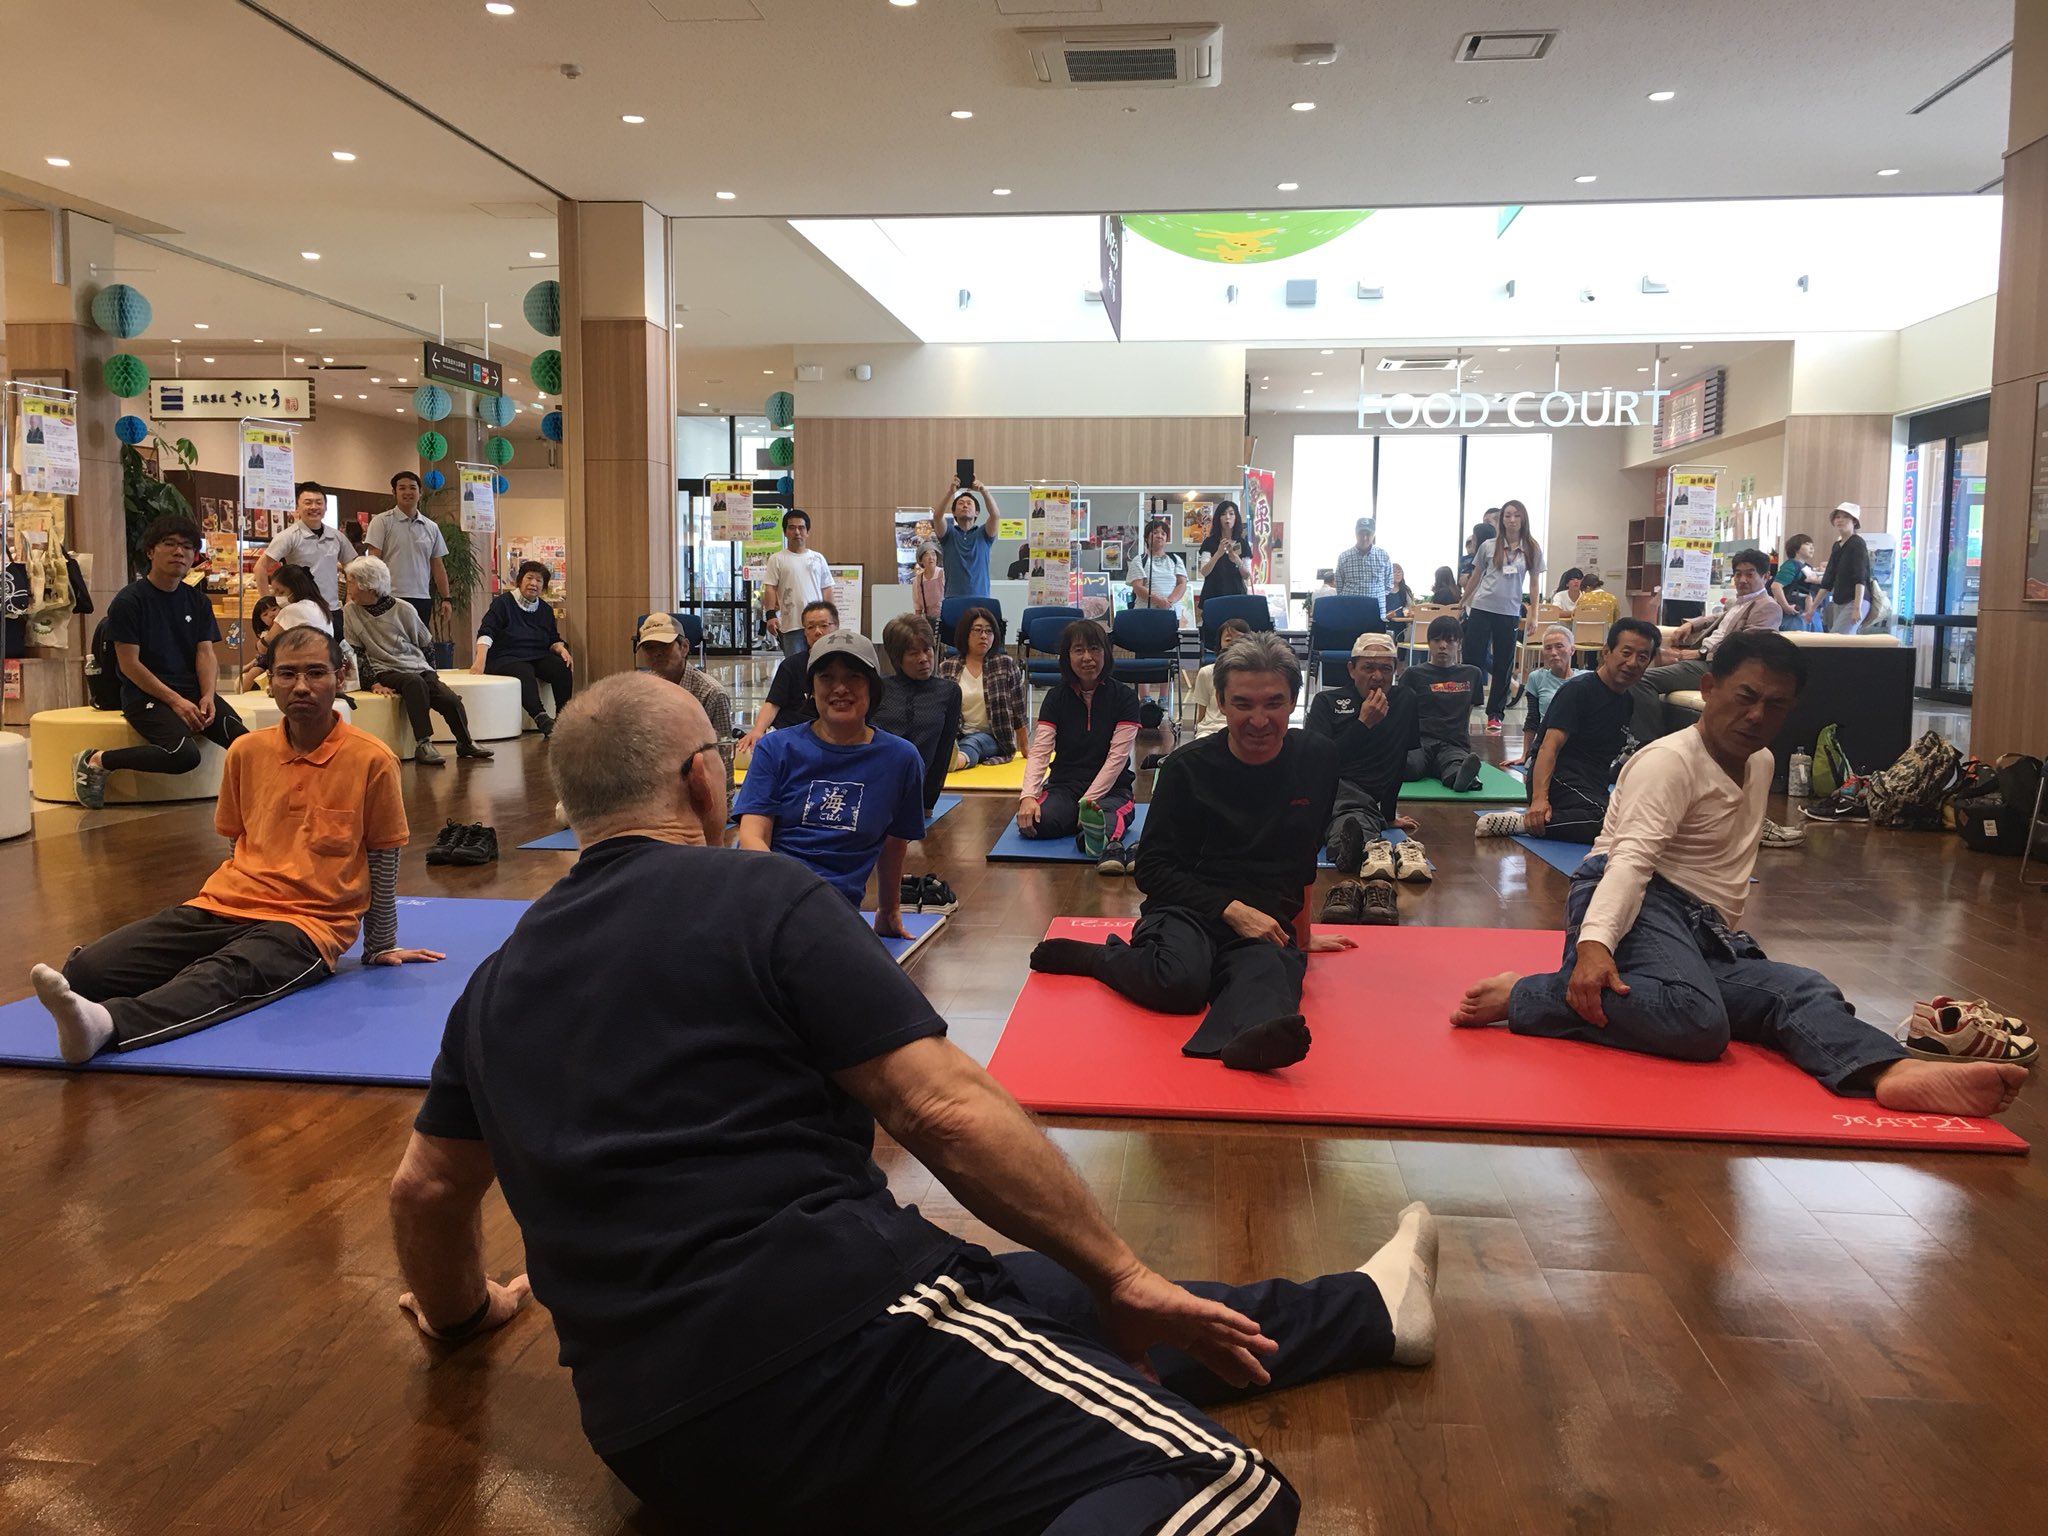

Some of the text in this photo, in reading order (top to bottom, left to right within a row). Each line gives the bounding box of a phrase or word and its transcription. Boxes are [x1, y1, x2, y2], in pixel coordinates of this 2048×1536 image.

[230, 388, 280, 408] さいとう
[1357, 393, 1490, 429] FOOD
[1507, 390, 1671, 428] COURT
[820, 791, 846, 814] 海
[819, 812, 842, 822] ごはん
